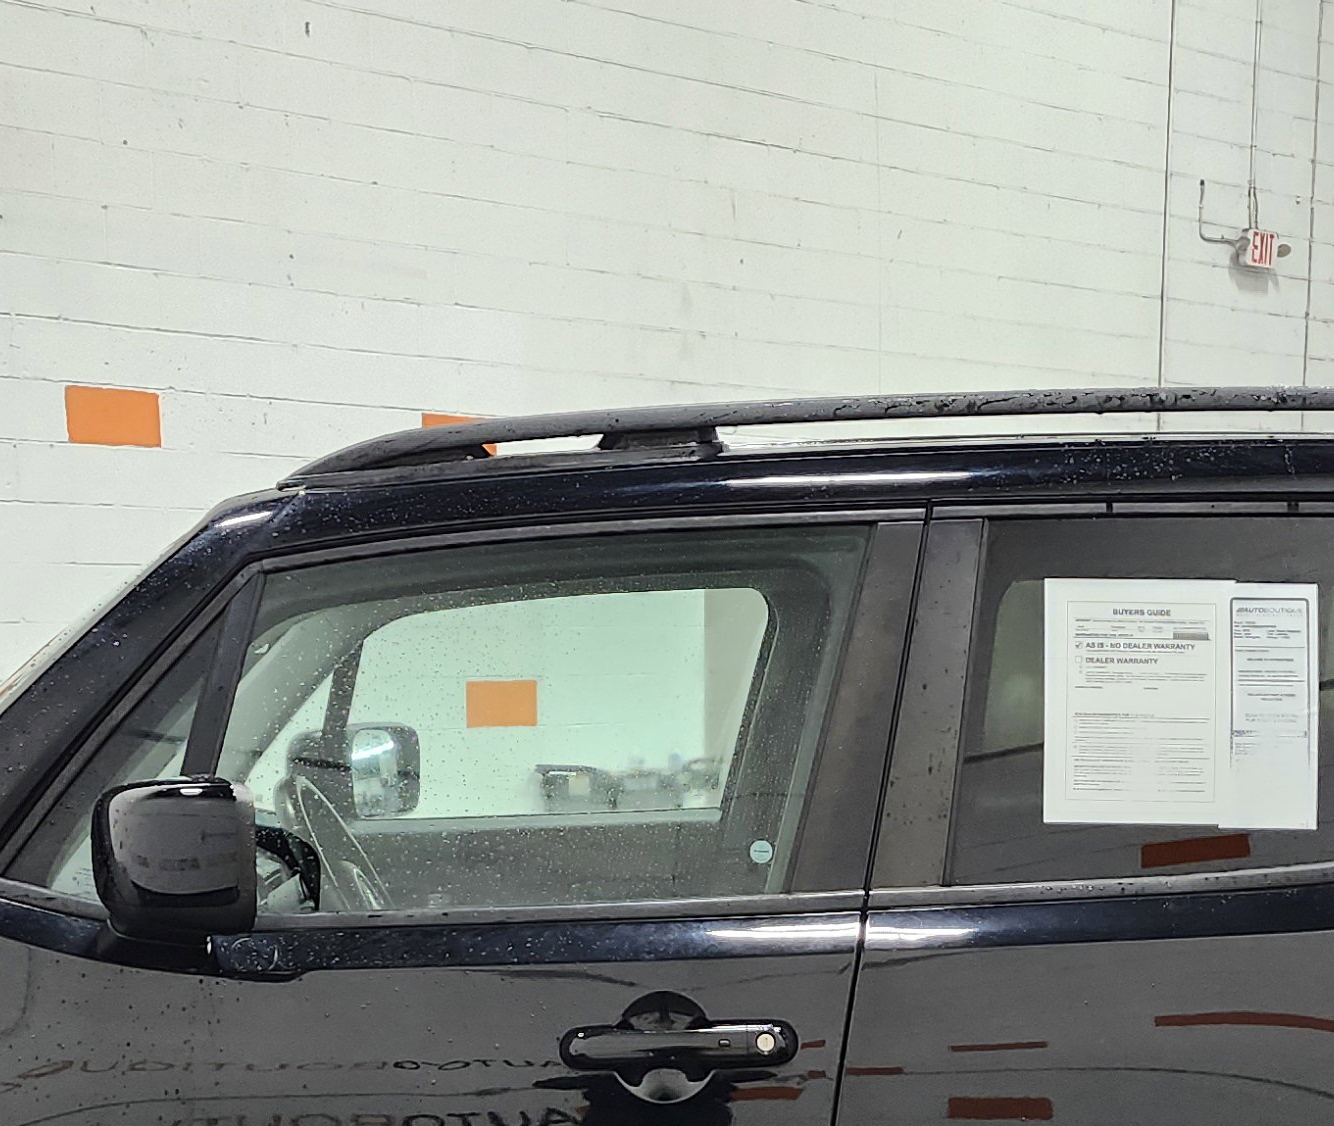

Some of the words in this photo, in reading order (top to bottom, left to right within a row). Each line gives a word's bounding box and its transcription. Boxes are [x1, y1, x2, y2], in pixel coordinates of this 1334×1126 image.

[1251, 230, 1275, 266] EXIT
[1112, 608, 1145, 616] BUYERS
[1146, 608, 1171, 617] GUIDE
[1123, 642, 1153, 650] DEALER
[1154, 643, 1195, 651] WARRANTY
[1085, 656, 1115, 664] DEALER
[1116, 657, 1159, 665] WARRANTY
